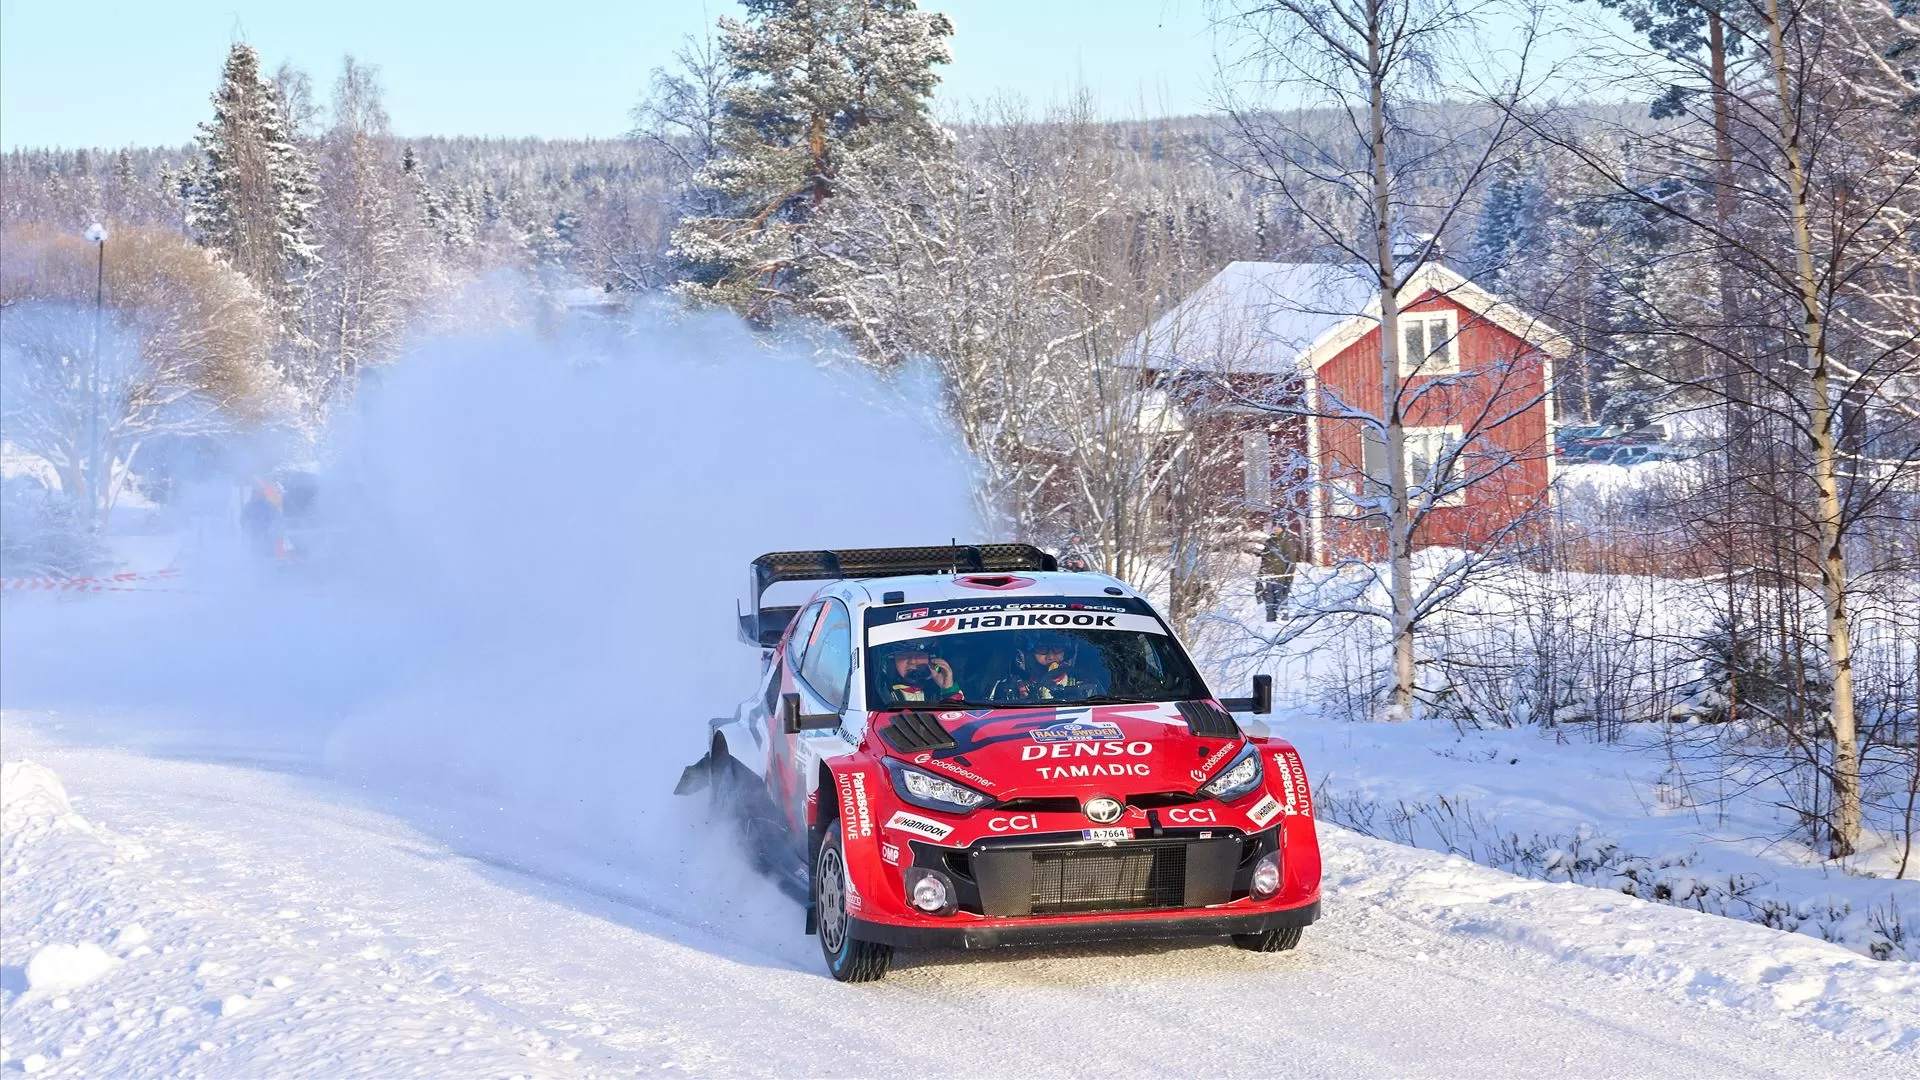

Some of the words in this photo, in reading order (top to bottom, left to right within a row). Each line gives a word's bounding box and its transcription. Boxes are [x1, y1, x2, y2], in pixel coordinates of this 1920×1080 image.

[898, 610, 928, 620] GR
[933, 604, 1001, 615] TOYOTA
[1005, 603, 1067, 611] GAZOO
[1035, 730, 1068, 738] RALLY
[1071, 727, 1118, 736] SWEDEN
[1022, 741, 1153, 761] DENSO
[931, 759, 994, 787] codebeamer
[1036, 763, 1150, 780] TAMADIC
[1273, 753, 1297, 815] Panasonic
[1286, 752, 1310, 817] AUTOMOTIVE
[838, 773, 858, 840] AUTOMOTIVE
[852, 772, 873, 837] Panasonic
[1093, 829, 1125, 839] A-7664
[882, 846, 899, 862] OMP
